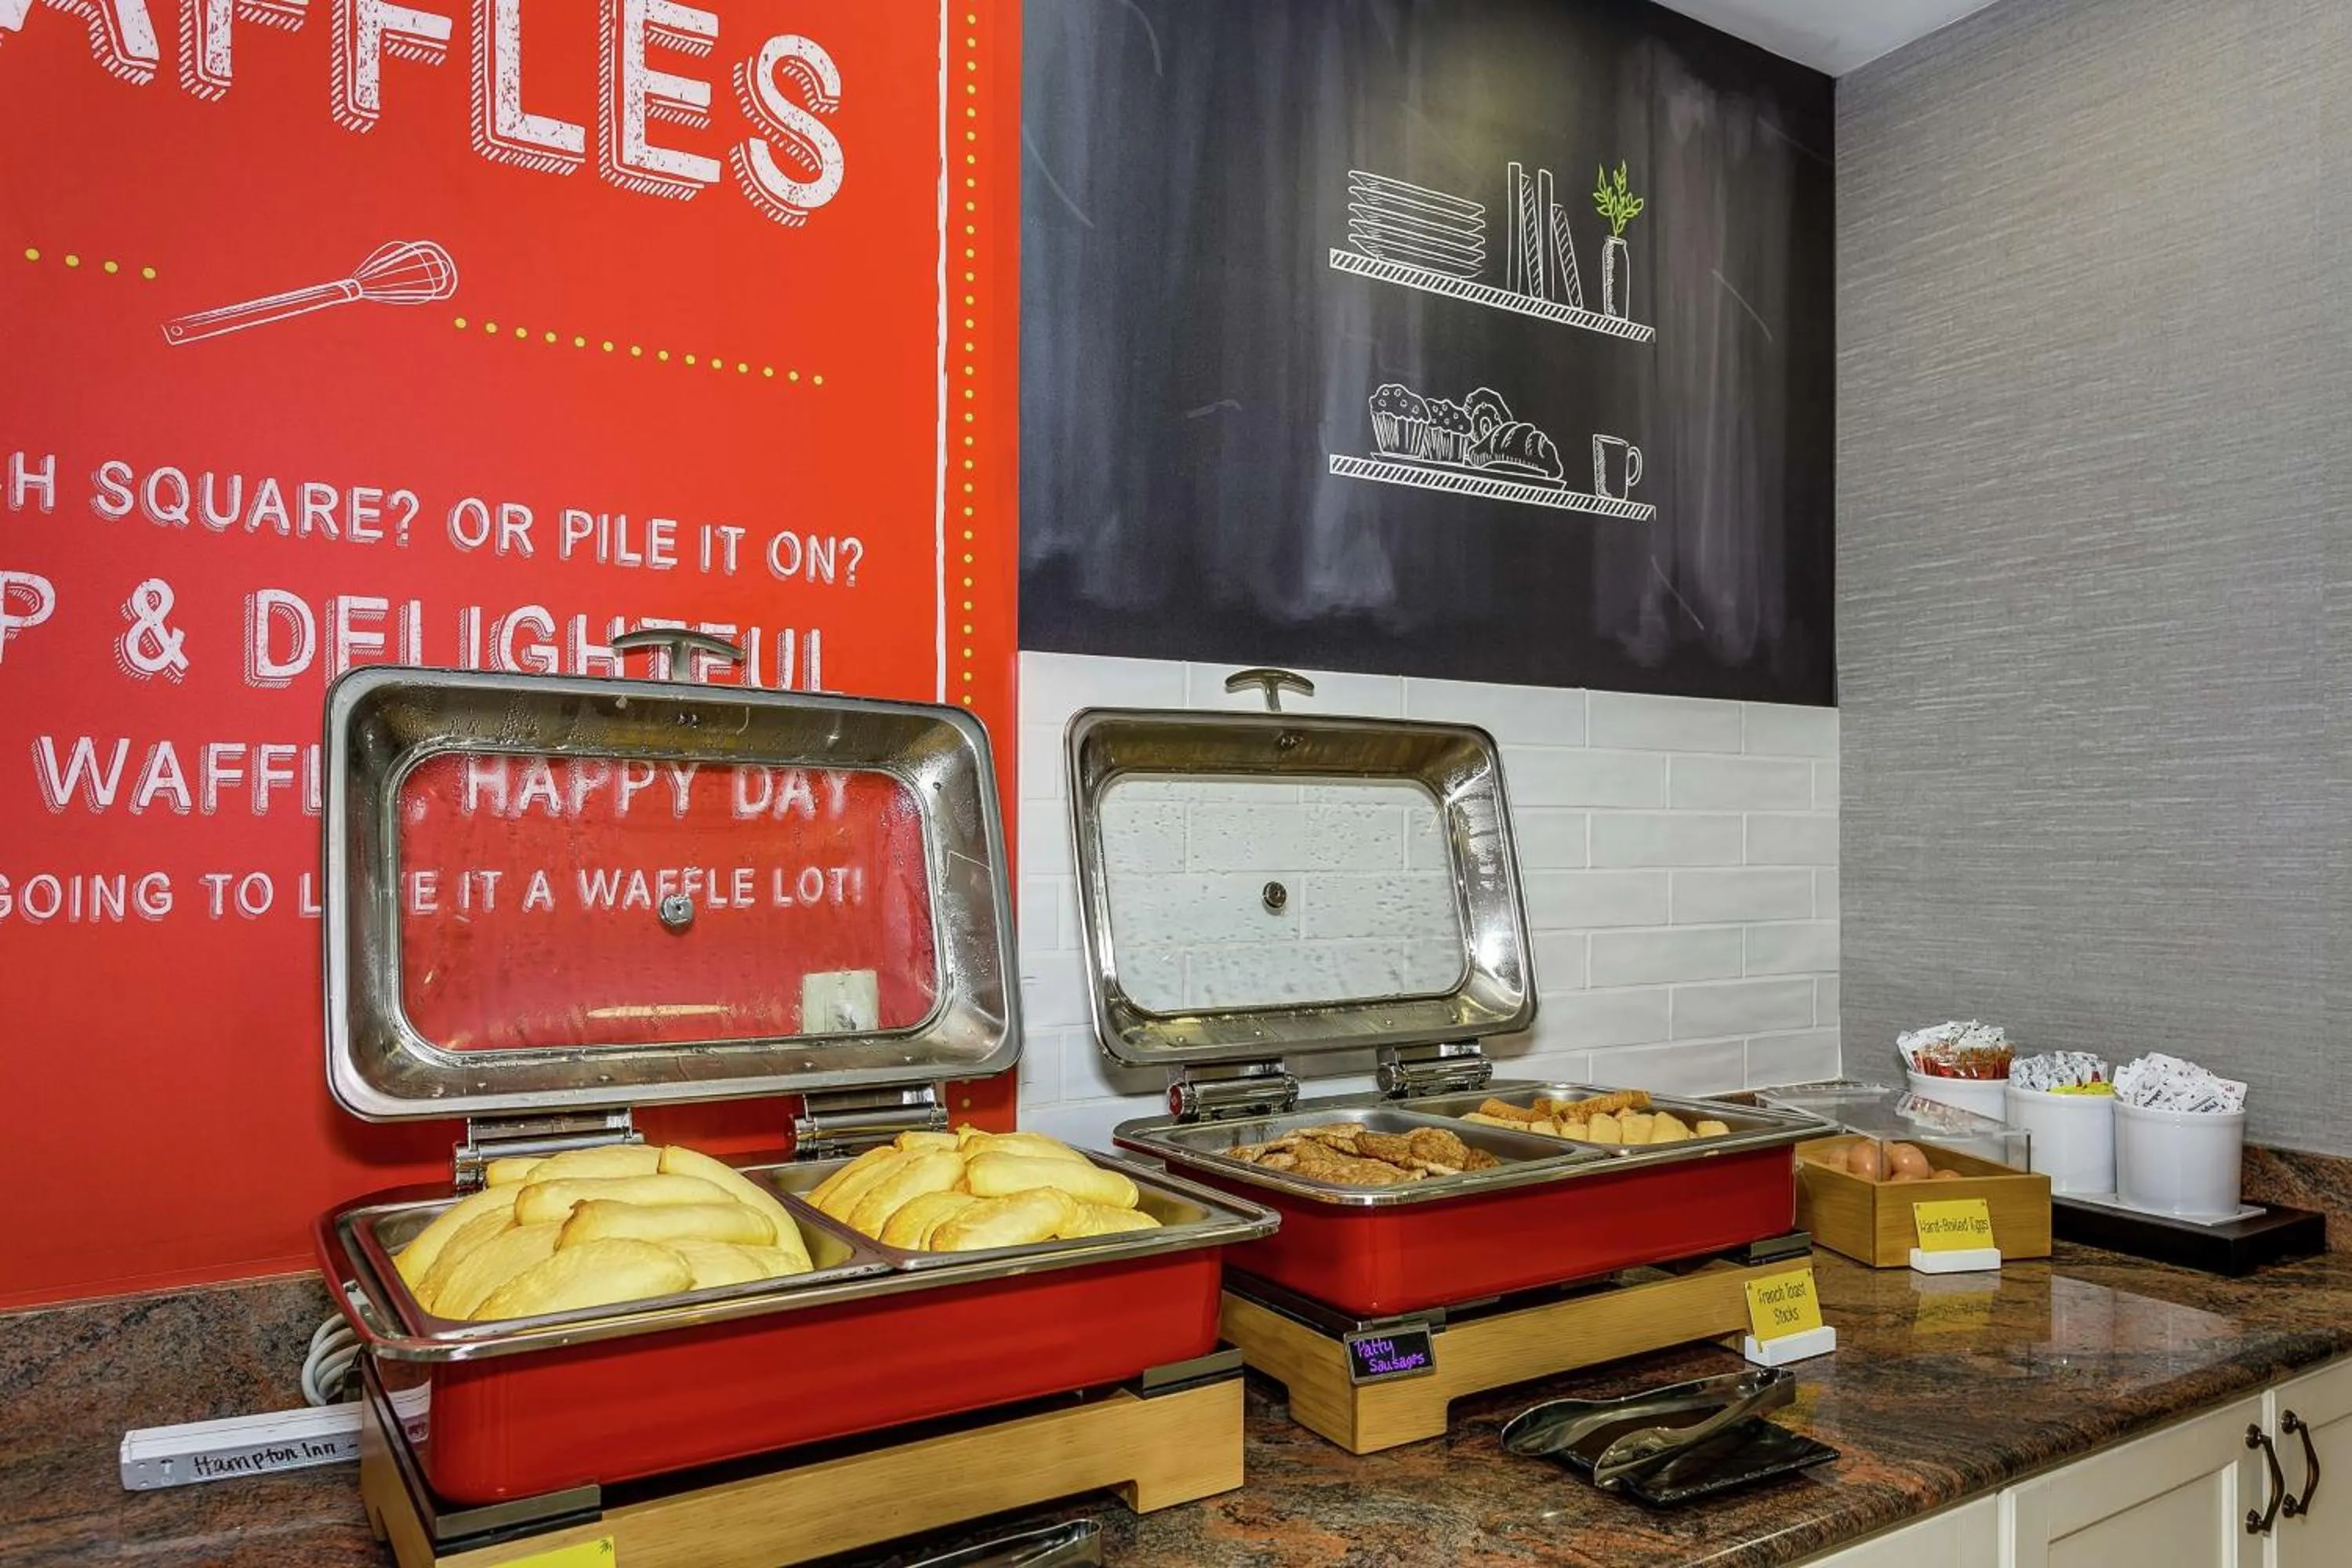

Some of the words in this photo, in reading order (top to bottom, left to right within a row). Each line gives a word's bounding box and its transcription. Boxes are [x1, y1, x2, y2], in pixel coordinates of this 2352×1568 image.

[0, 0, 844, 227] FLES
[90, 460, 420, 547] SQUARE?
[448, 498, 534, 559] OR
[559, 509, 677, 570] PILE
[699, 524, 746, 575] IT
[766, 531, 863, 587] ON?
[114, 578, 190, 687] &
[462, 757, 699, 818] HAPPY
[731, 764, 852, 819] DAY
[199, 872, 273, 920] TO
[459, 869, 503, 913] IT
[523, 869, 554, 913] A
[577, 867, 756, 910] WAFFLE
[771, 866, 863, 908] LOT!
[1919, 1217, 1968, 1233] Hard-Boiled
[1969, 1217, 1989, 1234] Eggs
[1757, 1285, 1785, 1305] French
[1785, 1282, 1807, 1299] Toast
[1354, 1336, 1395, 1359] Patty
[1369, 1353, 1425, 1373] Sausages
[194, 1448, 298, 1476] Hampton
[302, 1442, 336, 1459] Inn
